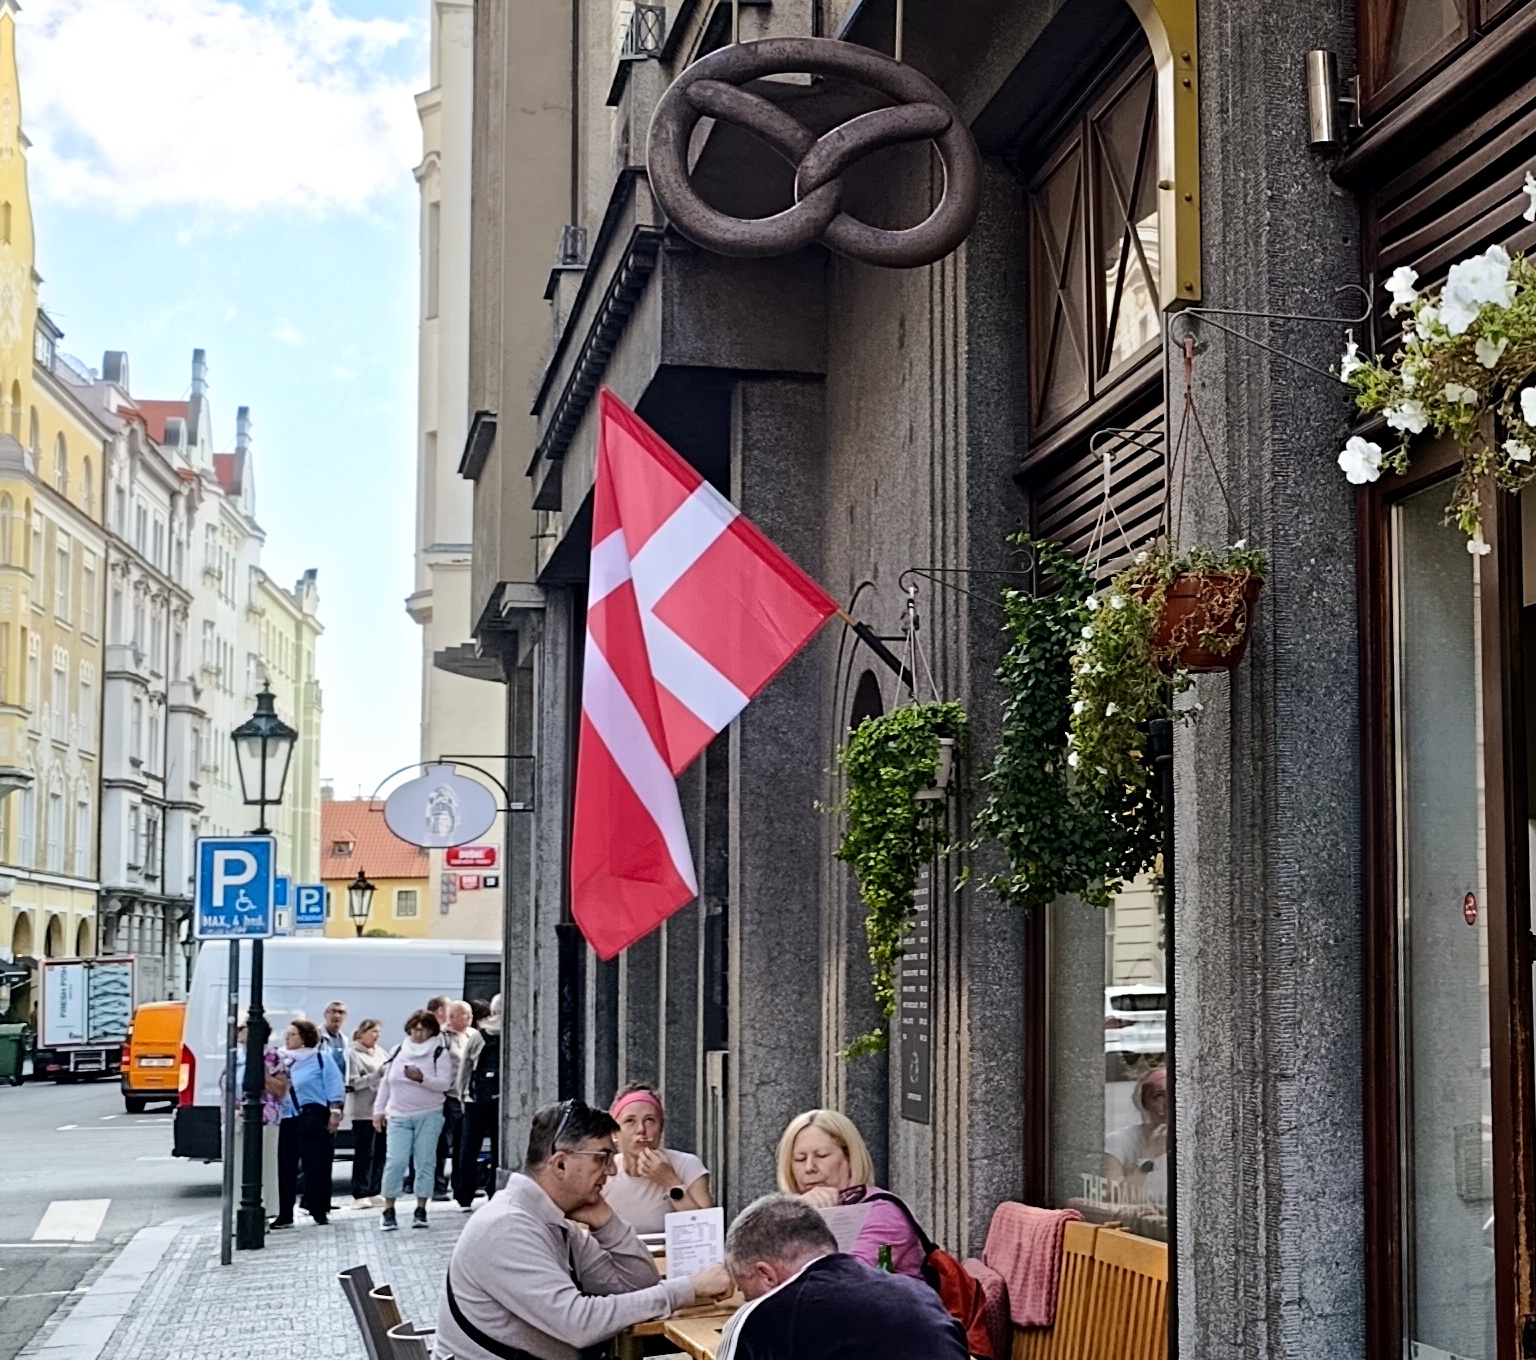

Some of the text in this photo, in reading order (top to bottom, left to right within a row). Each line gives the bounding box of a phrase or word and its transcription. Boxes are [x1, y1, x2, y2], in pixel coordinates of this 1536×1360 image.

[212, 849, 258, 908] P
[300, 888, 320, 914] P
[60, 966, 68, 1018] FRESH FISH
[1081, 1172, 1109, 1210] THE
